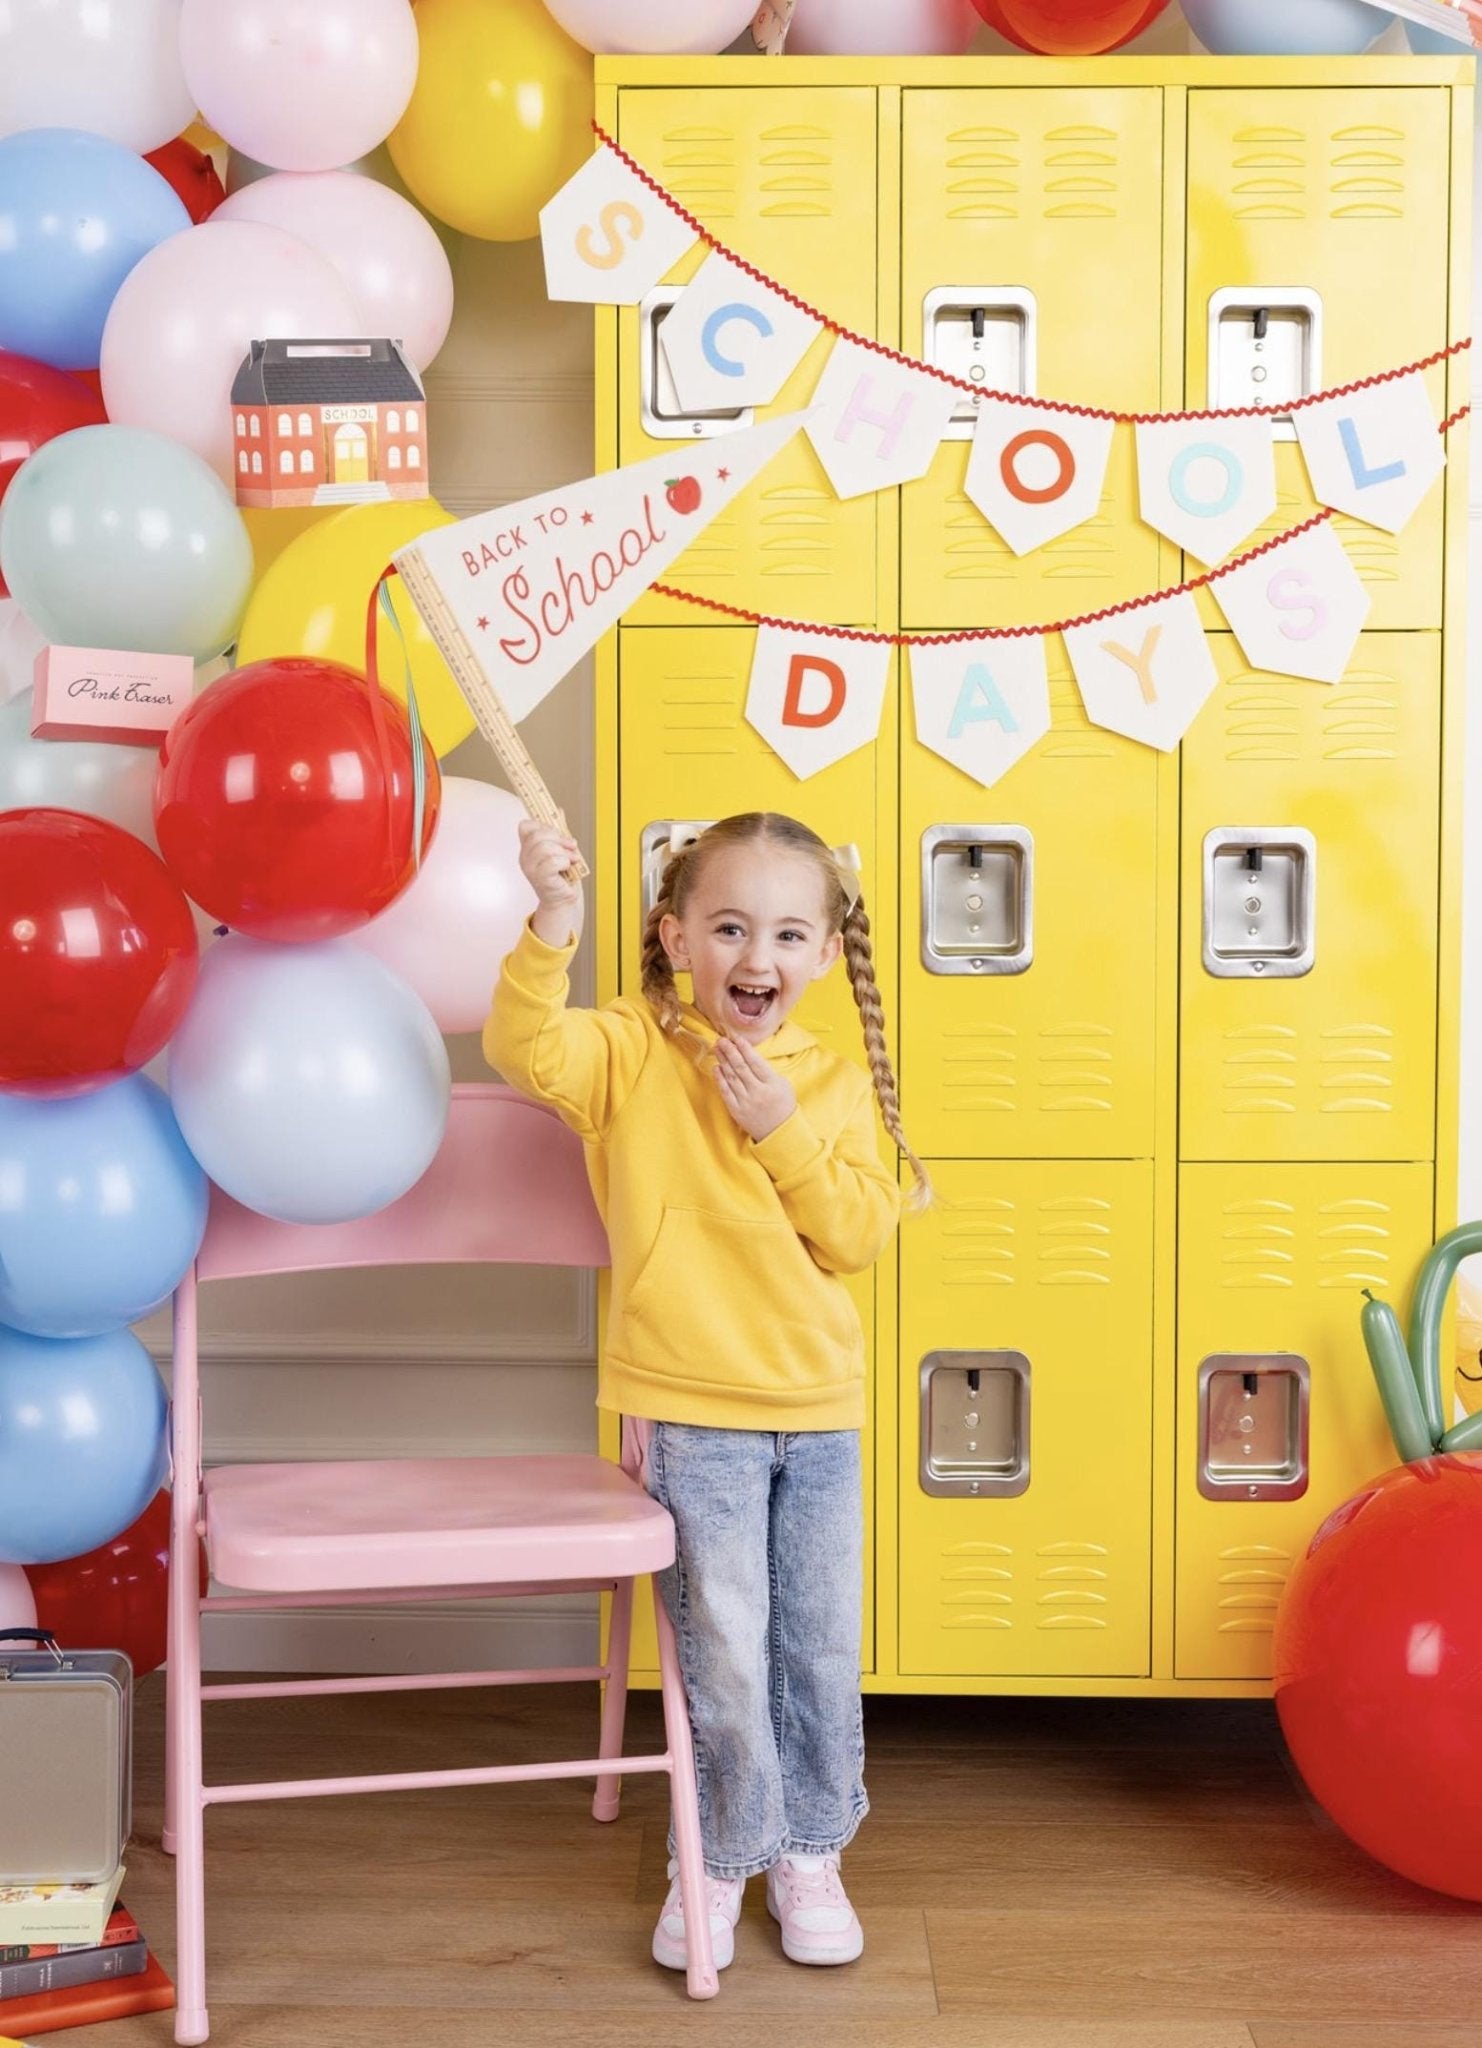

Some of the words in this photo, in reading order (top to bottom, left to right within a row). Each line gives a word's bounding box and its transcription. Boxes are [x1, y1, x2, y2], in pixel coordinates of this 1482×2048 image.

[324, 408, 374, 420] SCHOOL
[461, 525, 528, 577] BACK
[533, 507, 567, 534] TO
[499, 494, 666, 665] School
[67, 678, 121, 701] Pink
[123, 682, 175, 705] Eraser
